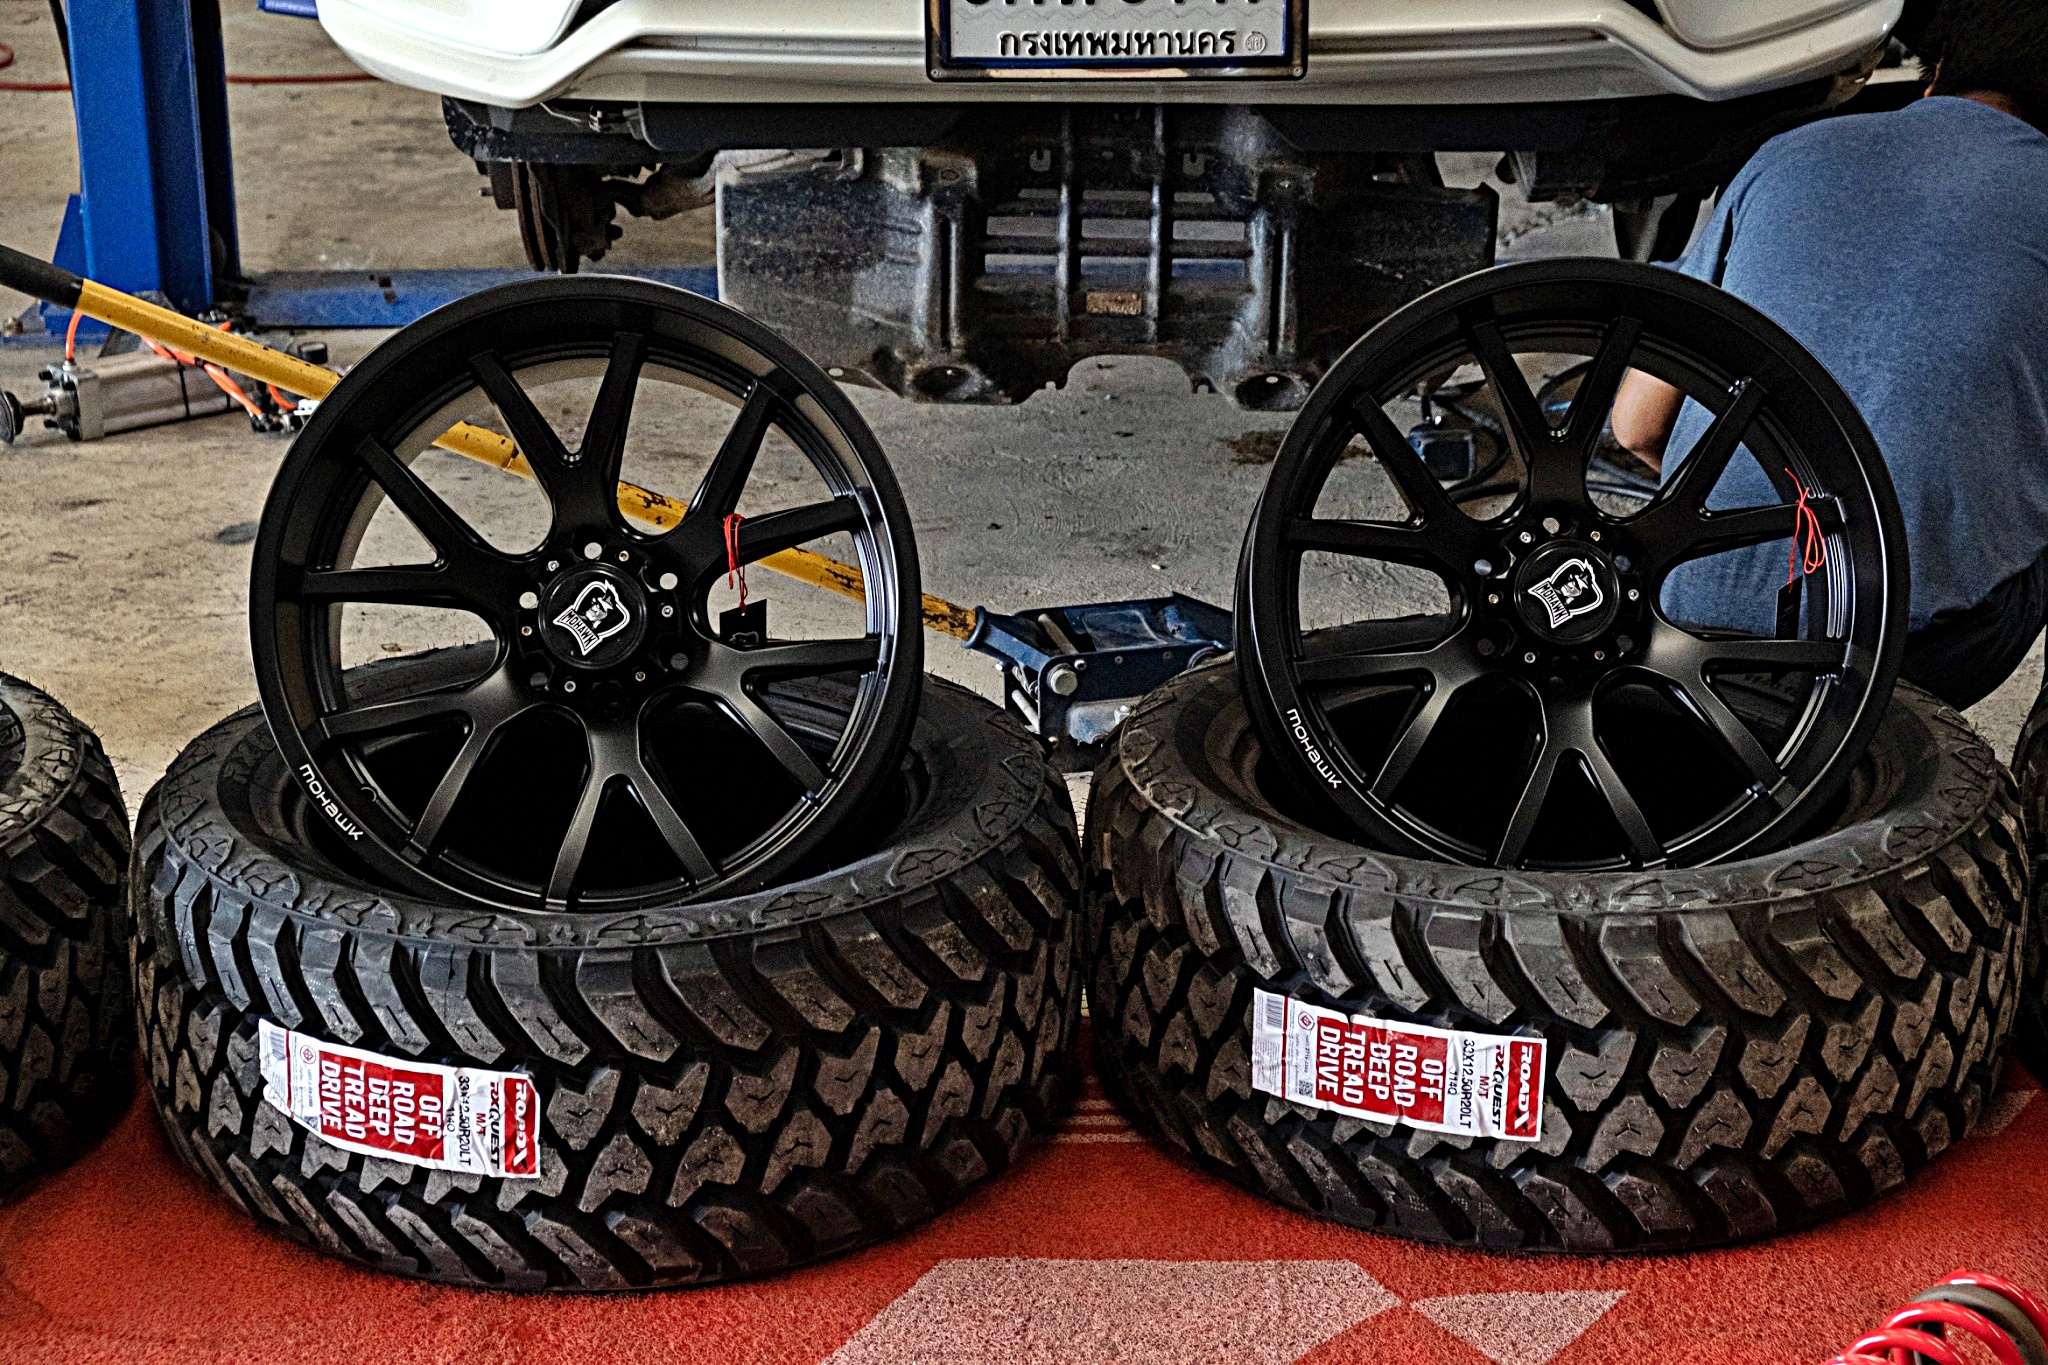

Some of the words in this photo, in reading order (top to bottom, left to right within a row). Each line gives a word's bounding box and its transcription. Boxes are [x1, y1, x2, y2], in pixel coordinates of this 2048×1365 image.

[999, 30, 1237, 56] กรงเทพมหานคร
[563, 611, 598, 647] MOHAWK
[1539, 583, 1569, 622] MOHAWK
[1318, 1025, 1341, 1096] DRIVE
[1342, 1031, 1366, 1104] TREAD
[1368, 1042, 1391, 1100] DEEP
[1394, 1044, 1418, 1107] ROAD
[1421, 1059, 1443, 1102] OFF
[1447, 1071, 1458, 1096] 114Q
[1459, 1039, 1475, 1129] 33X12.50R20LT
[1478, 1075, 1490, 1099] M/T
[1492, 1044, 1505, 1130] RXQUEST
[1513, 1044, 1533, 1132] ROADX
[321, 1060, 342, 1132] DRIVE
[344, 1066, 366, 1139] TREAD
[368, 1077, 390, 1136] DEEP
[392, 1081, 415, 1145] ROAD
[418, 1097, 442, 1140] OFF
[475, 1112, 486, 1137] M/T
[489, 1081, 501, 1170] RXQUEST
